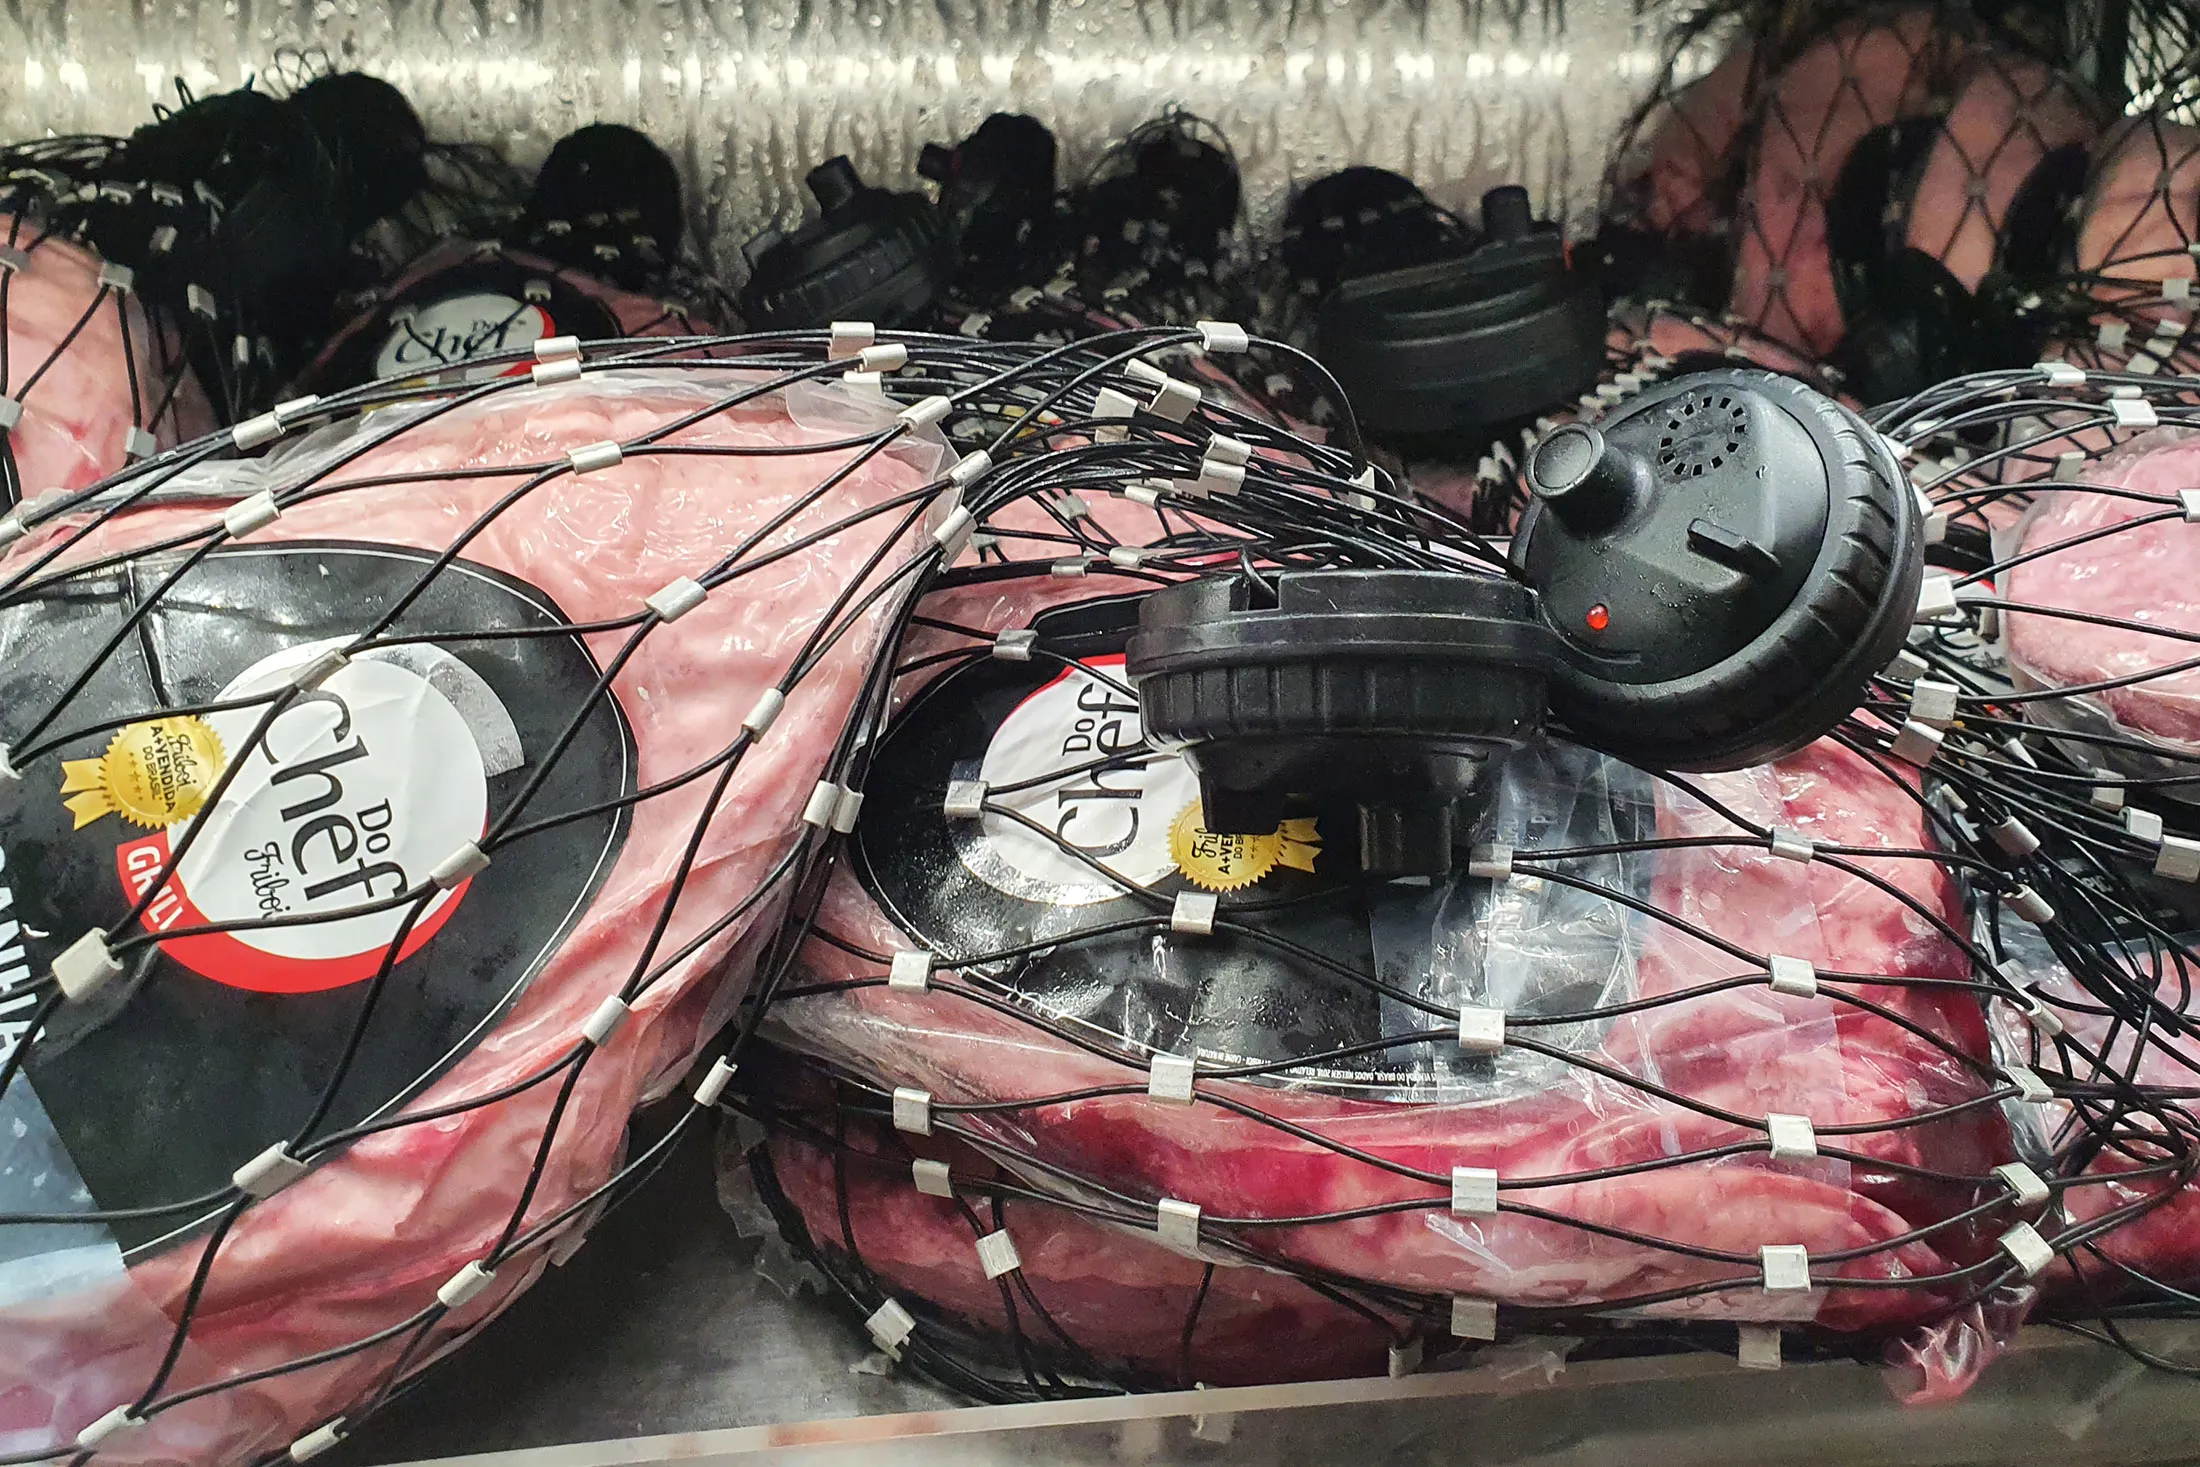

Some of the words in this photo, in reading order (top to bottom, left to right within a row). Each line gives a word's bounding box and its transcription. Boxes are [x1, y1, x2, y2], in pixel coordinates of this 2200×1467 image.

[142, 745, 154, 760] DO
[166, 733, 198, 791] Friboi
[1062, 717, 1096, 756] Do
[150, 725, 176, 813] A+VENDIDA
[259, 688, 409, 901] Chef
[1056, 683, 1148, 858] Chef
[356, 797, 393, 854] Do
[1191, 828, 1219, 858] Fri
[244, 841, 291, 919] Friboi
